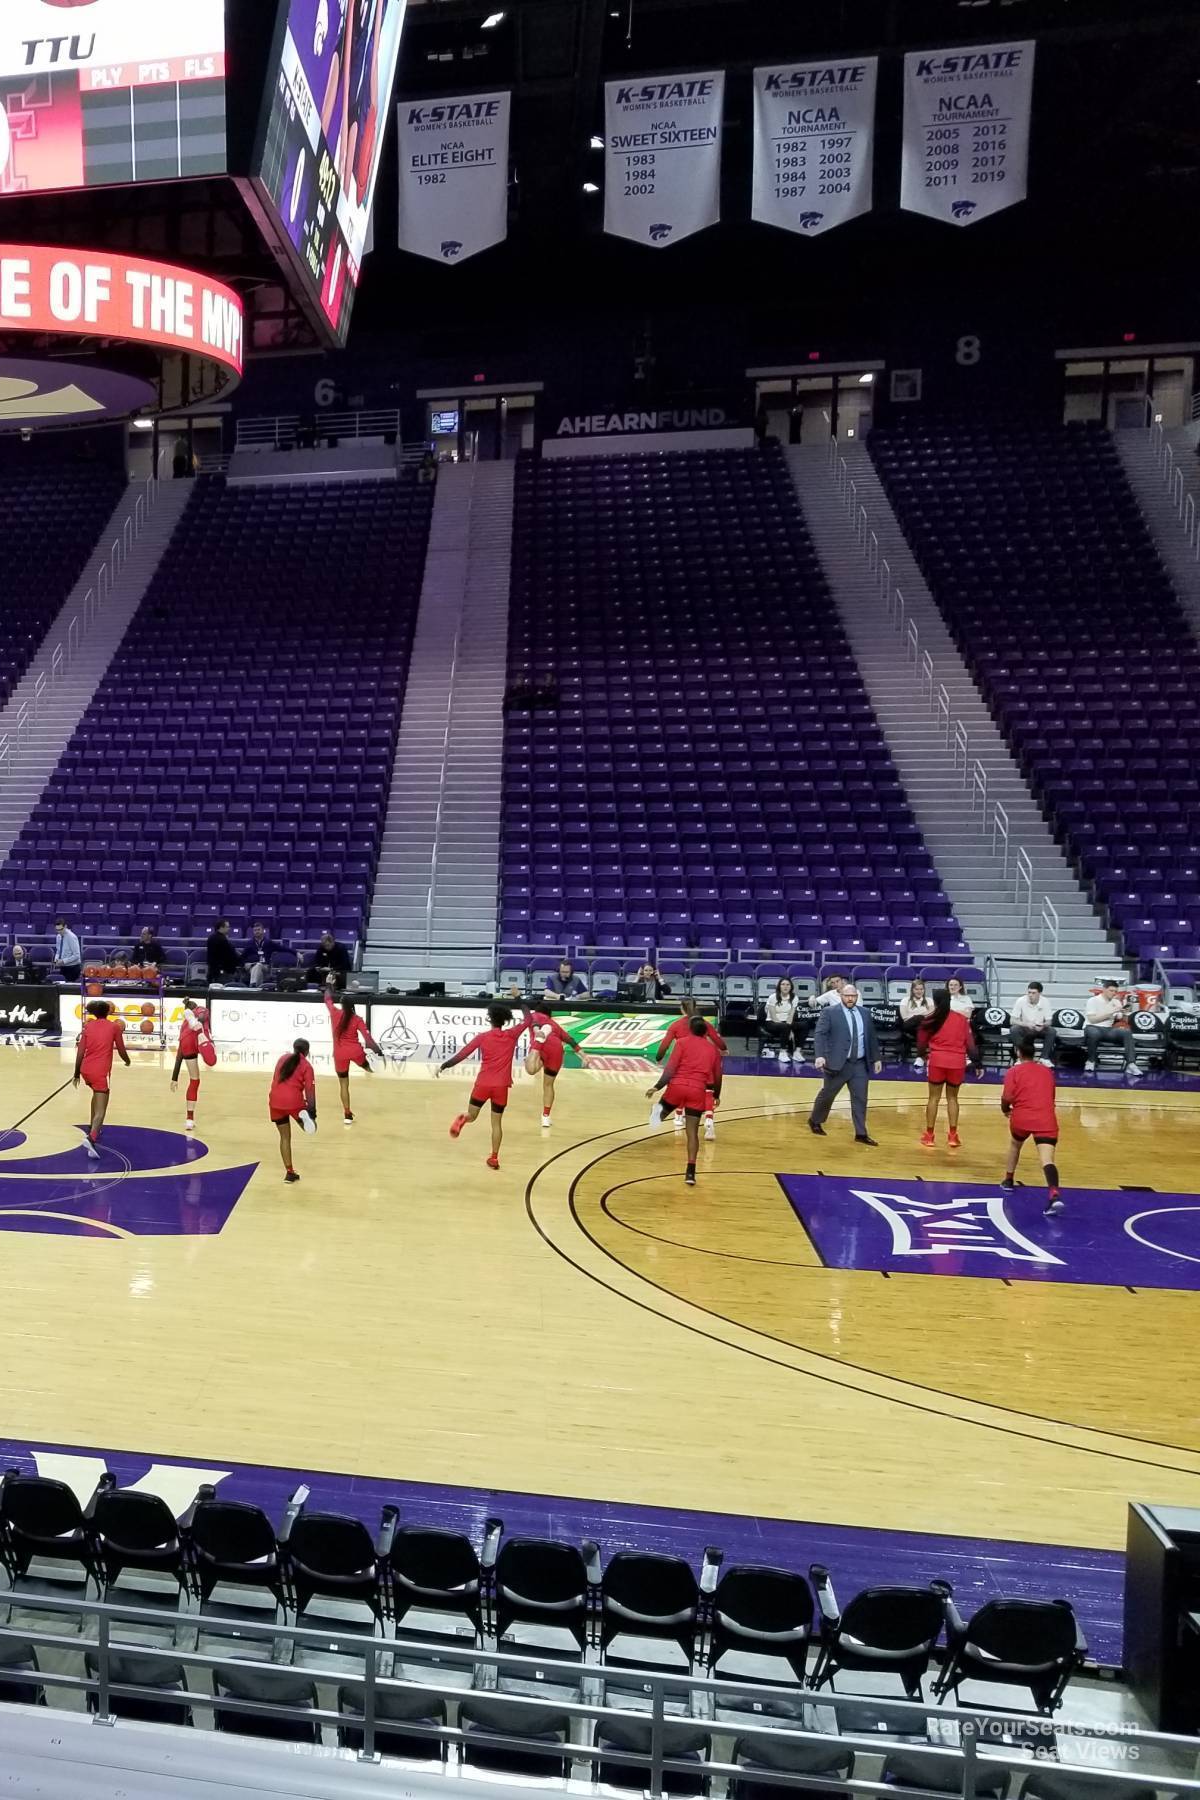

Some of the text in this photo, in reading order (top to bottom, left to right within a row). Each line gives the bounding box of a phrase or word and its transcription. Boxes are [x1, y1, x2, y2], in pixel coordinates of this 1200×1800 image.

[21, 32, 97, 66] TTU
[916, 50, 1023, 77] K-STATE
[91, 57, 216, 88] PLY PTS FLS
[764, 65, 866, 91] K-STATE
[963, 69, 1014, 82] BASKETBALL
[615, 79, 714, 105] K-STATE
[810, 84, 859, 96] BASKETBALL
[622, 98, 706, 113] WOMEN'S BASKETBALL
[938, 93, 994, 112] NCAA
[407, 100, 500, 125] K-STATE
[787, 106, 841, 125] NCAA
[932, 108, 999, 122] TOURNAMENT
[413, 117, 494, 132] WOMEN'S BASKETBALL
[651, 121, 677, 131] NCAA
[781, 122, 846, 135] TOURNAMENT
[925, 124, 1007, 142] 2005 2012
[440, 140, 465, 151] NCAA
[610, 126, 717, 148] SWEET SIXTEEN
[775, 137, 852, 153] 1982 1997
[925, 139, 1007, 157] 2008 2016
[411, 147, 495, 168] ELITE EIGHT
[624, 154, 656, 166] 1983
[775, 152, 851, 169] 1983 2002
[925, 155, 1006, 173] 2009 2017
[417, 172, 447, 186] 1982
[624, 169, 656, 182] 1984
[775, 167, 851, 184] 1984 2003
[925, 170, 1006, 188] 2011 2019
[623, 184, 655, 196] 2002
[774, 182, 851, 199] 1987 2004
[49, 261, 112, 323] OF
[125, 270, 194, 339] THE
[956, 335, 981, 366] 8
[314, 378, 336, 407] 6
[7, 1004, 48, 1024] Hut
[870, 1006, 897, 1016] Capitol
[1169, 1015, 1198, 1024] Capitol
[1171, 1022, 1198, 1030] Federal
[427, 1030, 457, 1046] Via
